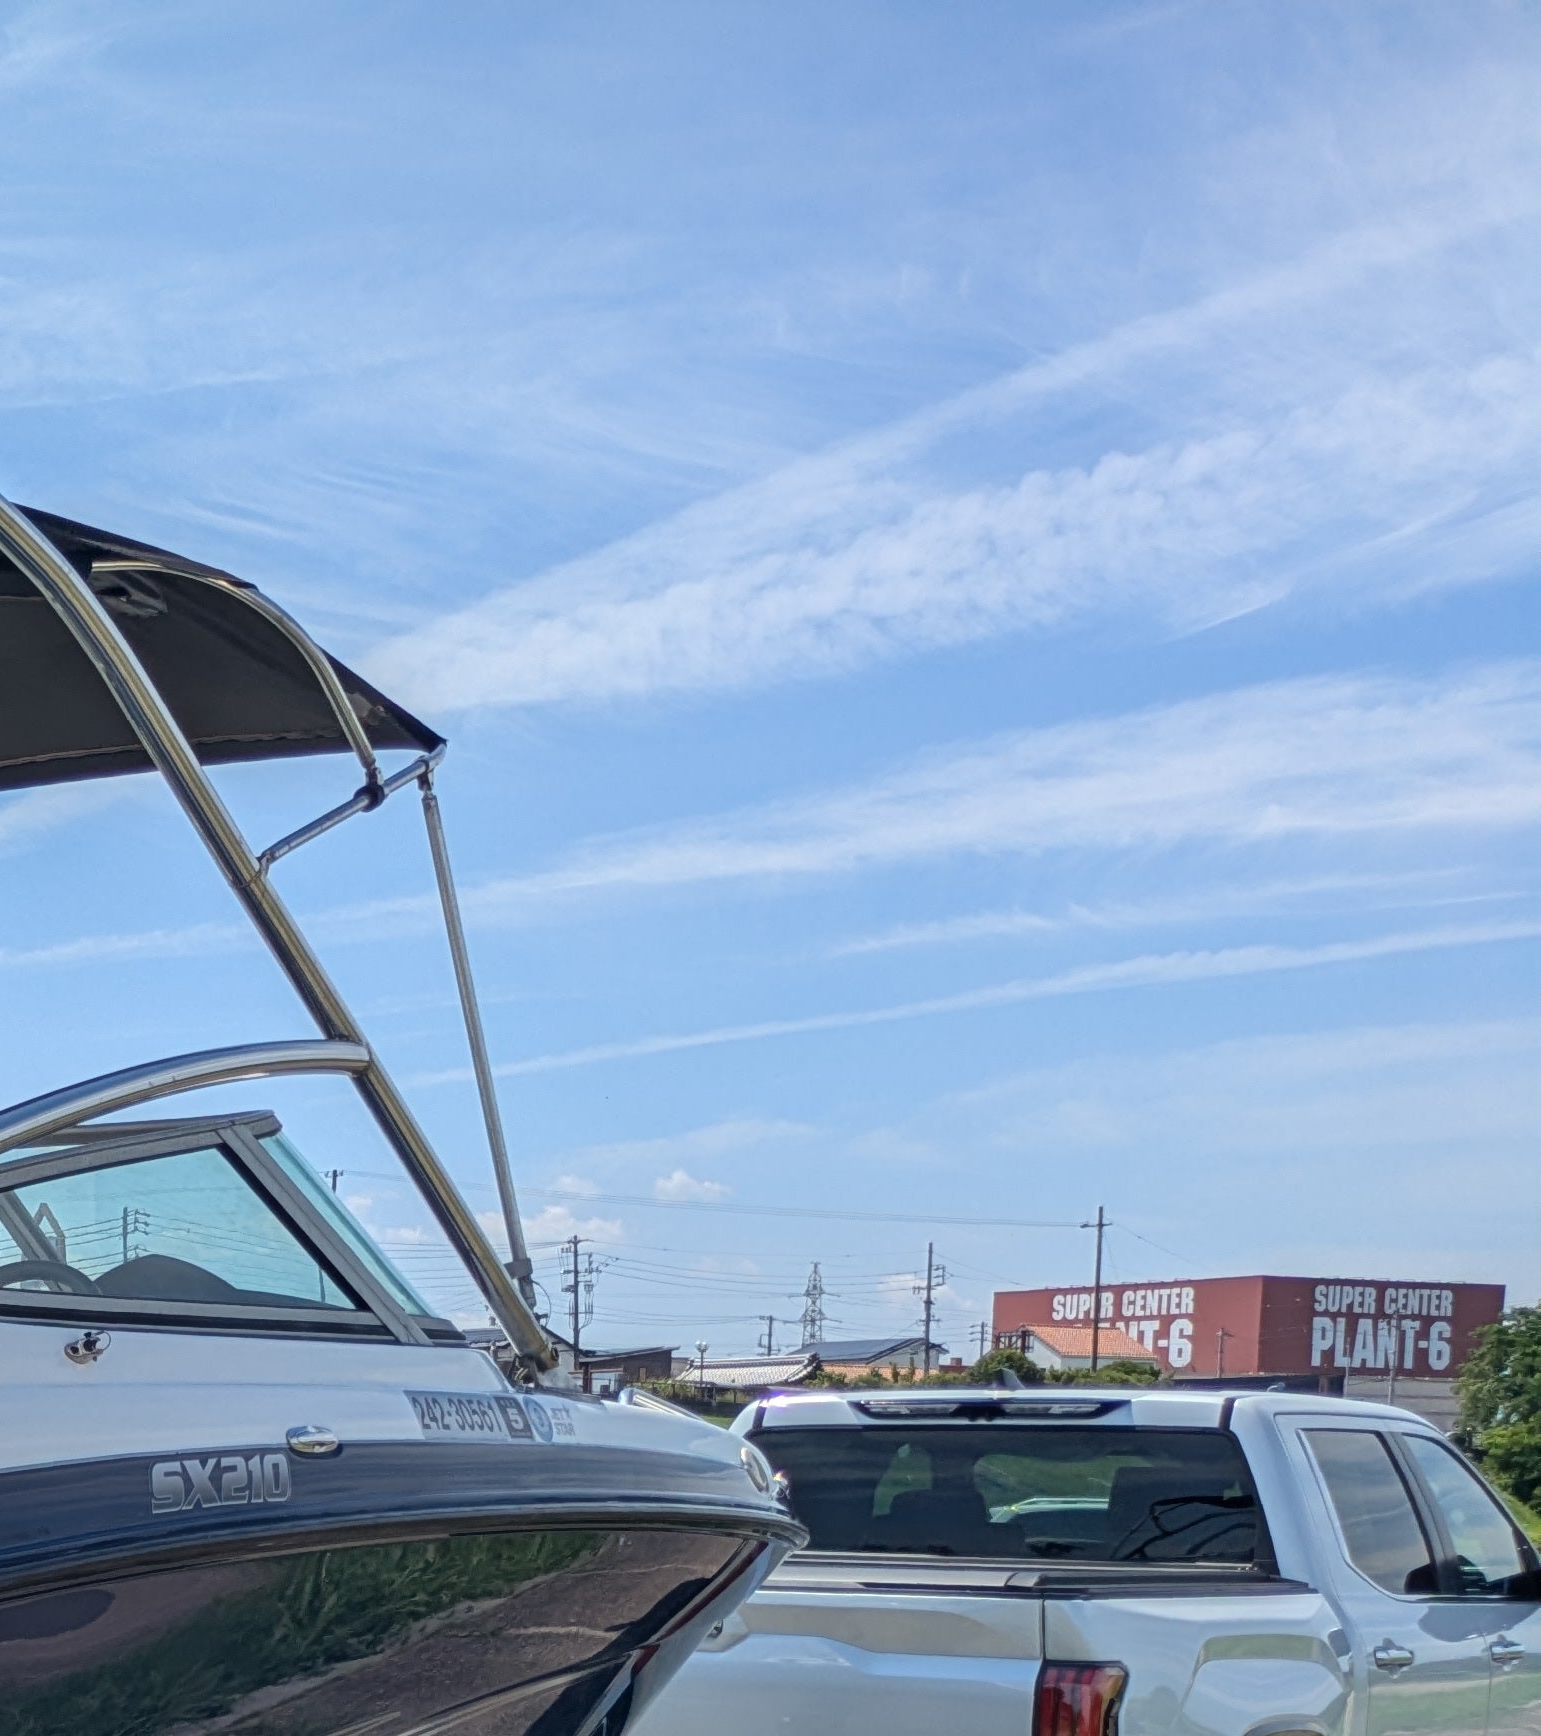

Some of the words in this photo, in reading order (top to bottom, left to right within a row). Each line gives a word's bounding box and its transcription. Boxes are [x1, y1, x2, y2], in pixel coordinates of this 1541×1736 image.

[1122, 1287, 1194, 1317] CENTER
[1314, 1285, 1376, 1314] SUPER
[1384, 1288, 1453, 1317] CENTER
[1311, 1317, 1452, 1371] PLANT-6
[411, 1397, 503, 1432] 242-30561
[505, 1407, 525, 1431] 5
[149, 1453, 291, 1515] SX210
